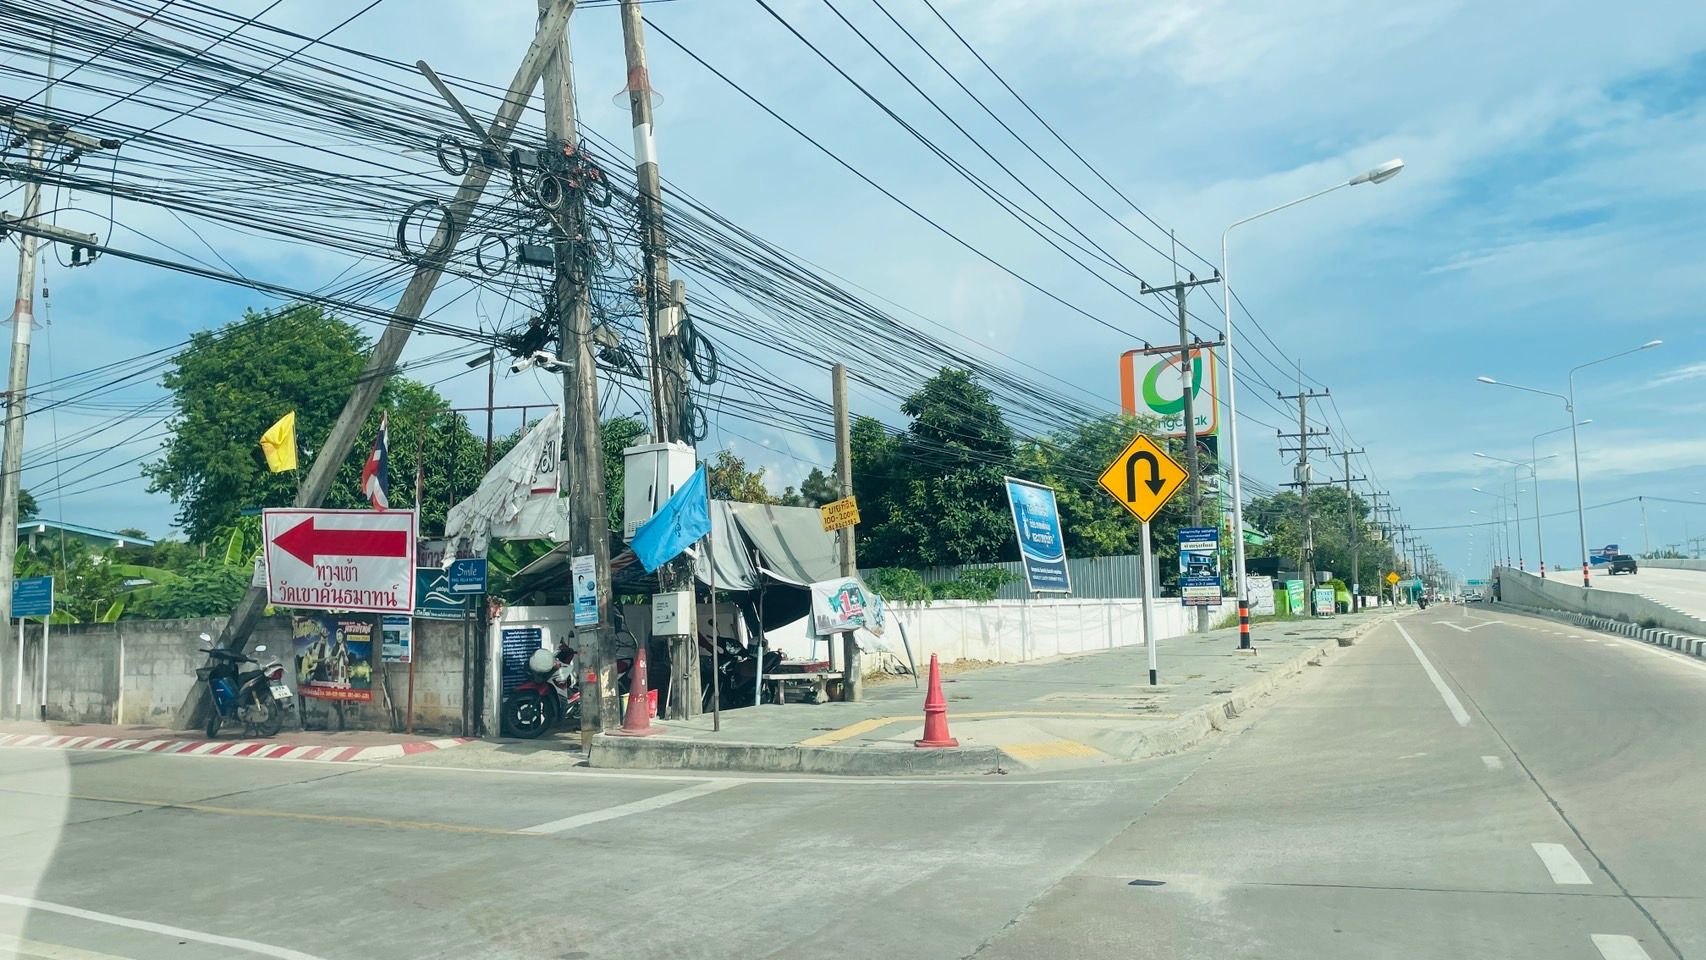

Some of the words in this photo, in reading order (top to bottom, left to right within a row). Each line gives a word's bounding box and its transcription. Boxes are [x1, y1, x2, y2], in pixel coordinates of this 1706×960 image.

[316, 558, 359, 584] ทางเข้า
[457, 562, 477, 577] Smile
[279, 580, 400, 607] วัดเขาคันธมาทน์
